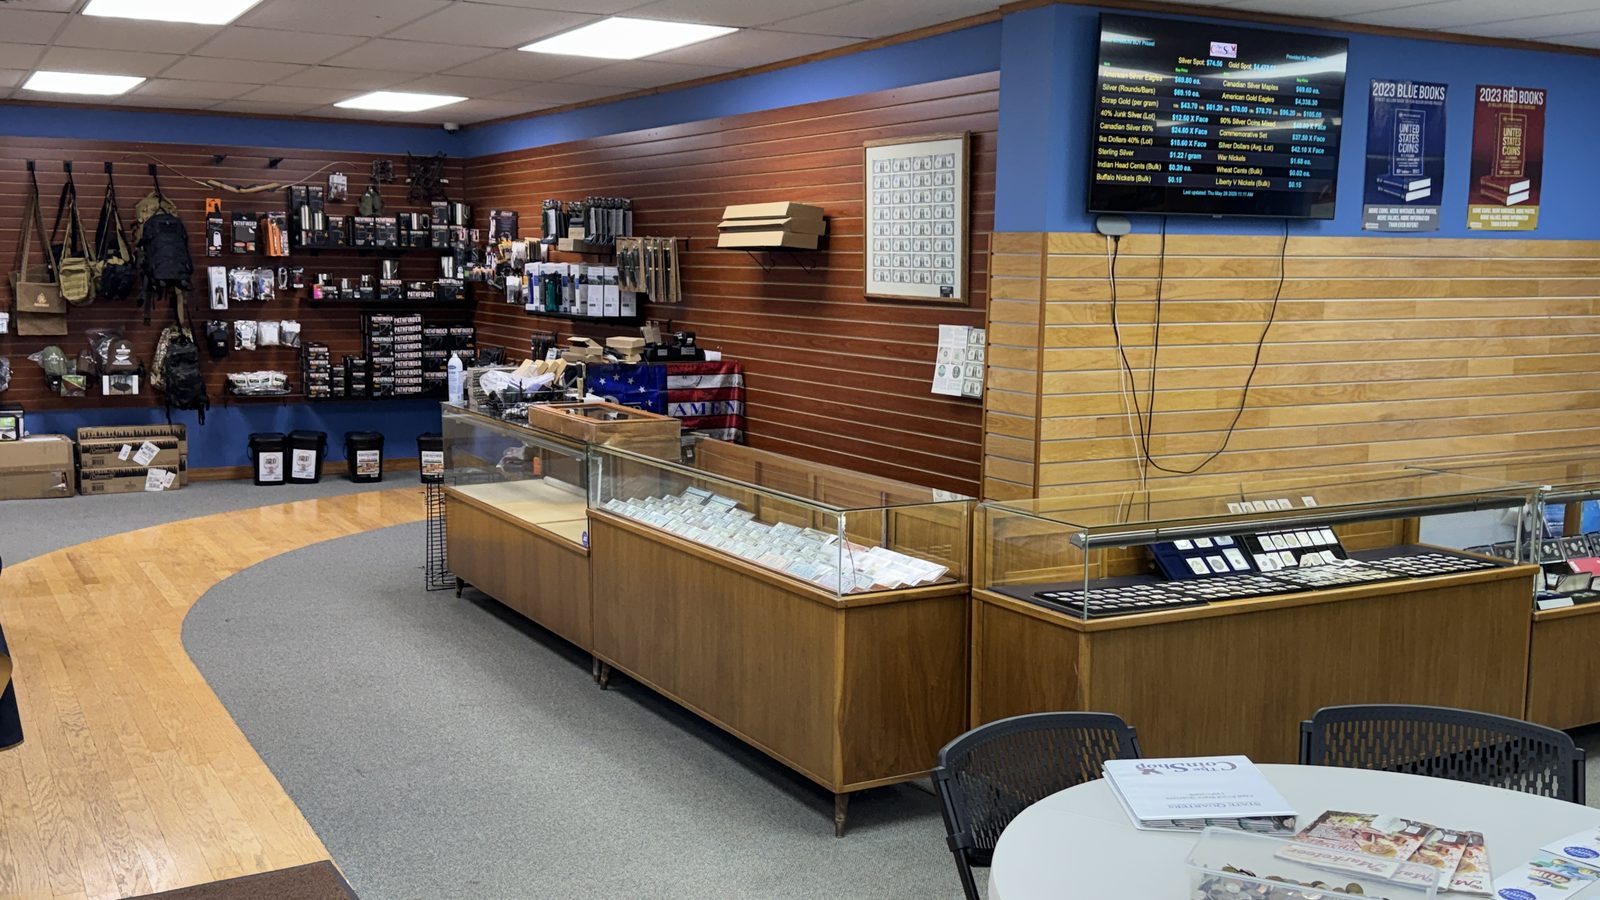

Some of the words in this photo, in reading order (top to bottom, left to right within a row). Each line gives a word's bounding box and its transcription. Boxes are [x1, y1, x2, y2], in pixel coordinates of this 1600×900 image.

[1179, 56, 1193, 64] Silver
[1228, 61, 1240, 69] Gold
[1104, 70, 1129, 78] American
[1129, 72, 1145, 80] Silver
[1145, 73, 1162, 82] Eagles
[1102, 83, 1117, 91] Silver
[1118, 84, 1156, 95] (Rounds/Bars)
[1223, 80, 1246, 88] Canadian
[1261, 83, 1278, 92] Maples
[1372, 82, 1395, 97] 2023
[1397, 84, 1418, 99] BLUE
[1419, 85, 1446, 101] BOOKS
[1480, 88, 1501, 102] 2023
[1503, 89, 1518, 104] RED
[1519, 90, 1544, 105] BOOKS
[1101, 96, 1117, 105] Scrap
[1118, 97, 1131, 105] Gold
[1131, 98, 1142, 107] (per
[1143, 99, 1159, 108] gram)
[1221, 92, 1245, 100] American
[1258, 95, 1275, 103] Eagles
[1100, 109, 1113, 117] 40%
[1113, 110, 1127, 118] Junk
[1127, 111, 1142, 119] Silver
[1142, 112, 1156, 120] (Lot)
[1195, 115, 1209, 123] Face
[1099, 122, 1125, 131] Canadian
[1125, 123, 1141, 131] Silver
[1232, 117, 1246, 125] Silver
[1247, 118, 1260, 126] Coins
[1194, 127, 1208, 135] Face
[1399, 123, 1420, 134] UNITED
[1503, 127, 1522, 137] UNITED
[1219, 130, 1258, 138] Commemorative
[1398, 133, 1420, 144] STATES
[1108, 135, 1127, 144] Dollars
[1127, 136, 1140, 144] 40%
[1140, 137, 1154, 146] (Lot)
[1193, 140, 1207, 148] Face
[1502, 137, 1521, 146] STATES
[1233, 142, 1250, 150] Dollars
[1312, 147, 1325, 155] Face
[1398, 143, 1419, 154] COINS
[1502, 146, 1521, 156] COINS
[1098, 147, 1118, 157] Sterling
[1119, 148, 1135, 157] Silver
[1187, 153, 1202, 161] gram
[1217, 153, 1228, 161] War
[1228, 154, 1246, 162] Nickels
[1097, 160, 1114, 168] Indian
[1114, 161, 1128, 169] Head
[1129, 162, 1146, 170] Cents
[1146, 163, 1162, 172] (Bulk)
[1216, 166, 1232, 174] Wheat
[1248, 168, 1263, 176] (Bulk)
[1096, 173, 1116, 181] Buffalo
[1116, 174, 1135, 182] Nickels
[1135, 175, 1152, 183] (Bulk)
[1215, 179, 1232, 188] Liberty
[1238, 180, 1255, 188] Nickels
[1256, 180, 1270, 189] (Bulk)
[394, 325, 421, 333] PATHFINDER
[394, 334, 421, 342] PATHFINDER
